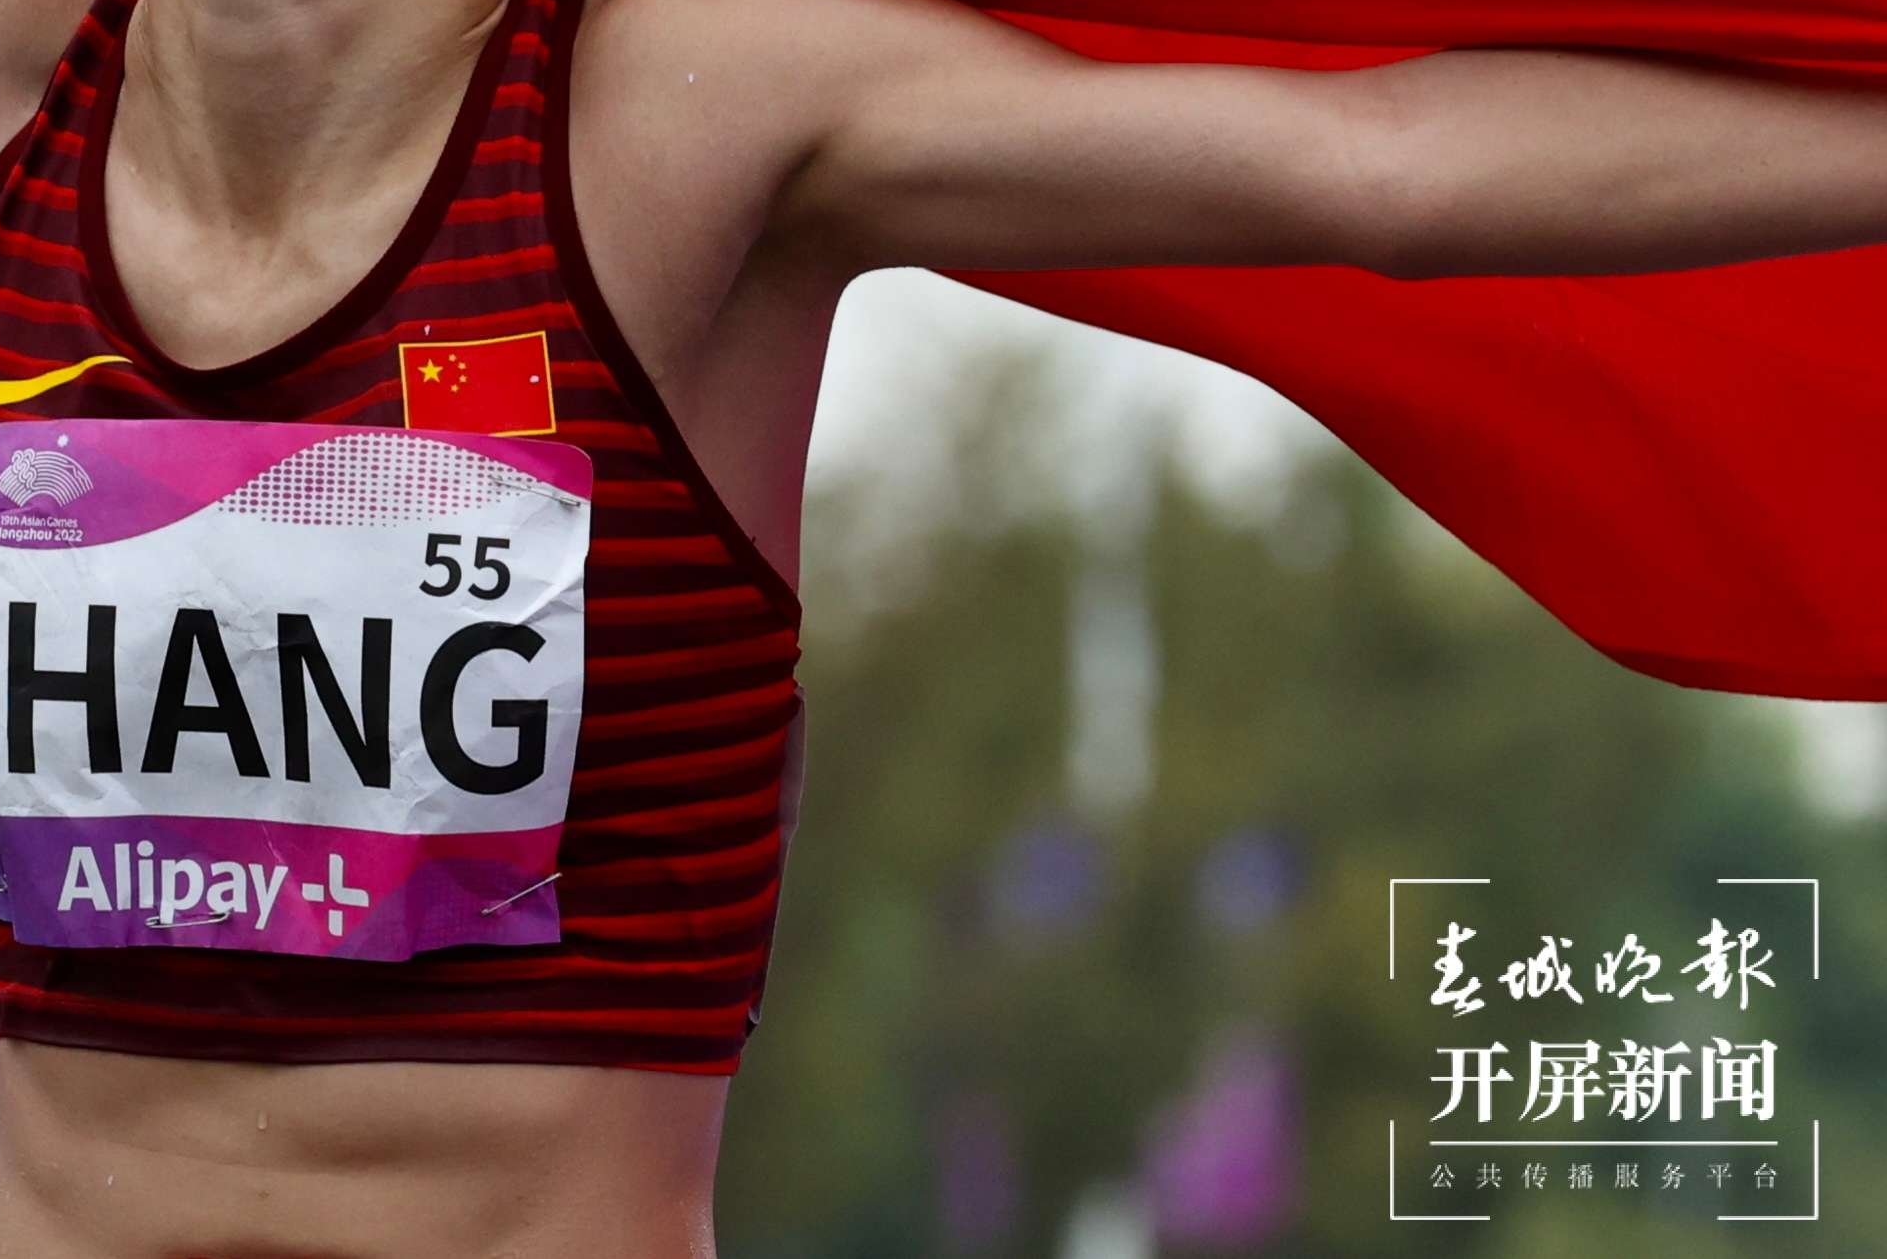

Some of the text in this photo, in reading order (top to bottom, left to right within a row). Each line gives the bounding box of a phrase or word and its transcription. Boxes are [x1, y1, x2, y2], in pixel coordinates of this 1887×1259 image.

[0, 515, 78, 528] 19th Asian Games
[54, 529, 84, 542] 2022
[419, 533, 512, 600] 55
[58, 841, 288, 930] Alipay
